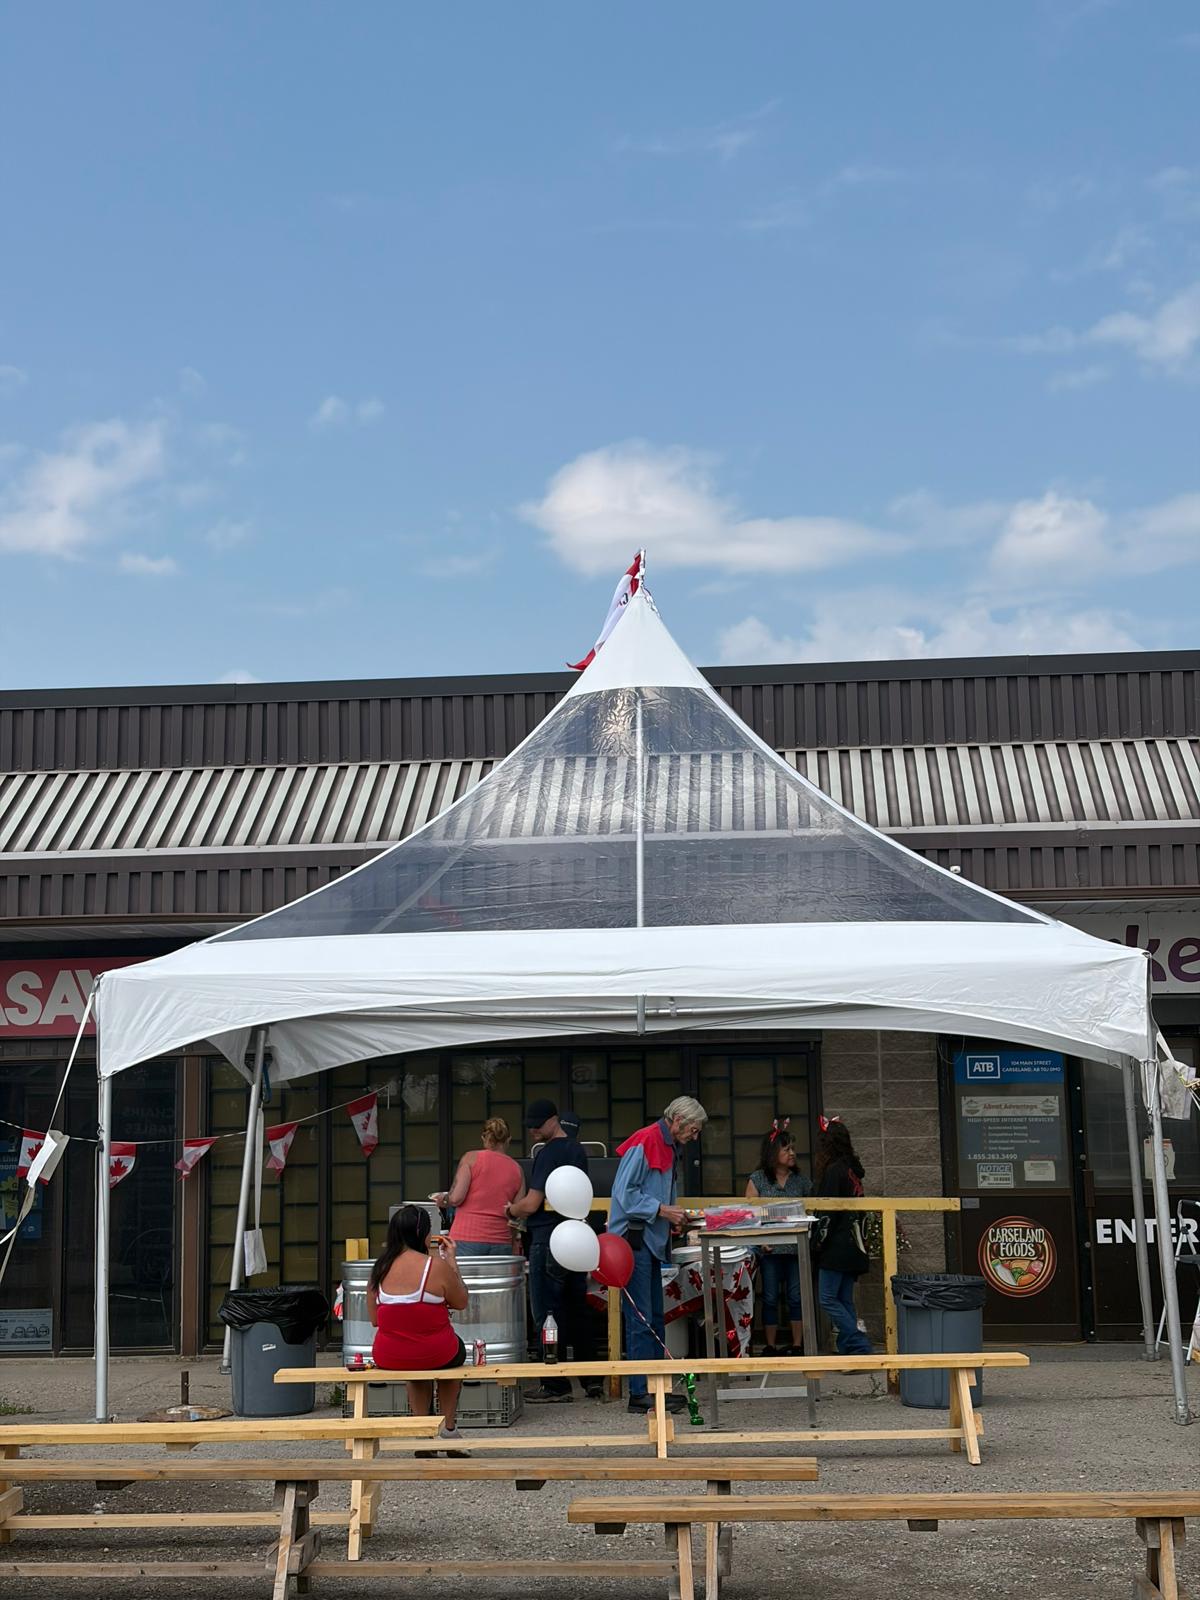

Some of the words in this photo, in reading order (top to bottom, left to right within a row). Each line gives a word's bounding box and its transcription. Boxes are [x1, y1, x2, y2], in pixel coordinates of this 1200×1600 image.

[1108, 925, 1200, 982] ke
[0, 970, 97, 1026] SA
[973, 1062, 994, 1073] ATB
[988, 1228, 1045, 1243] CARSELAND
[1000, 1242, 1036, 1257] FOODS
